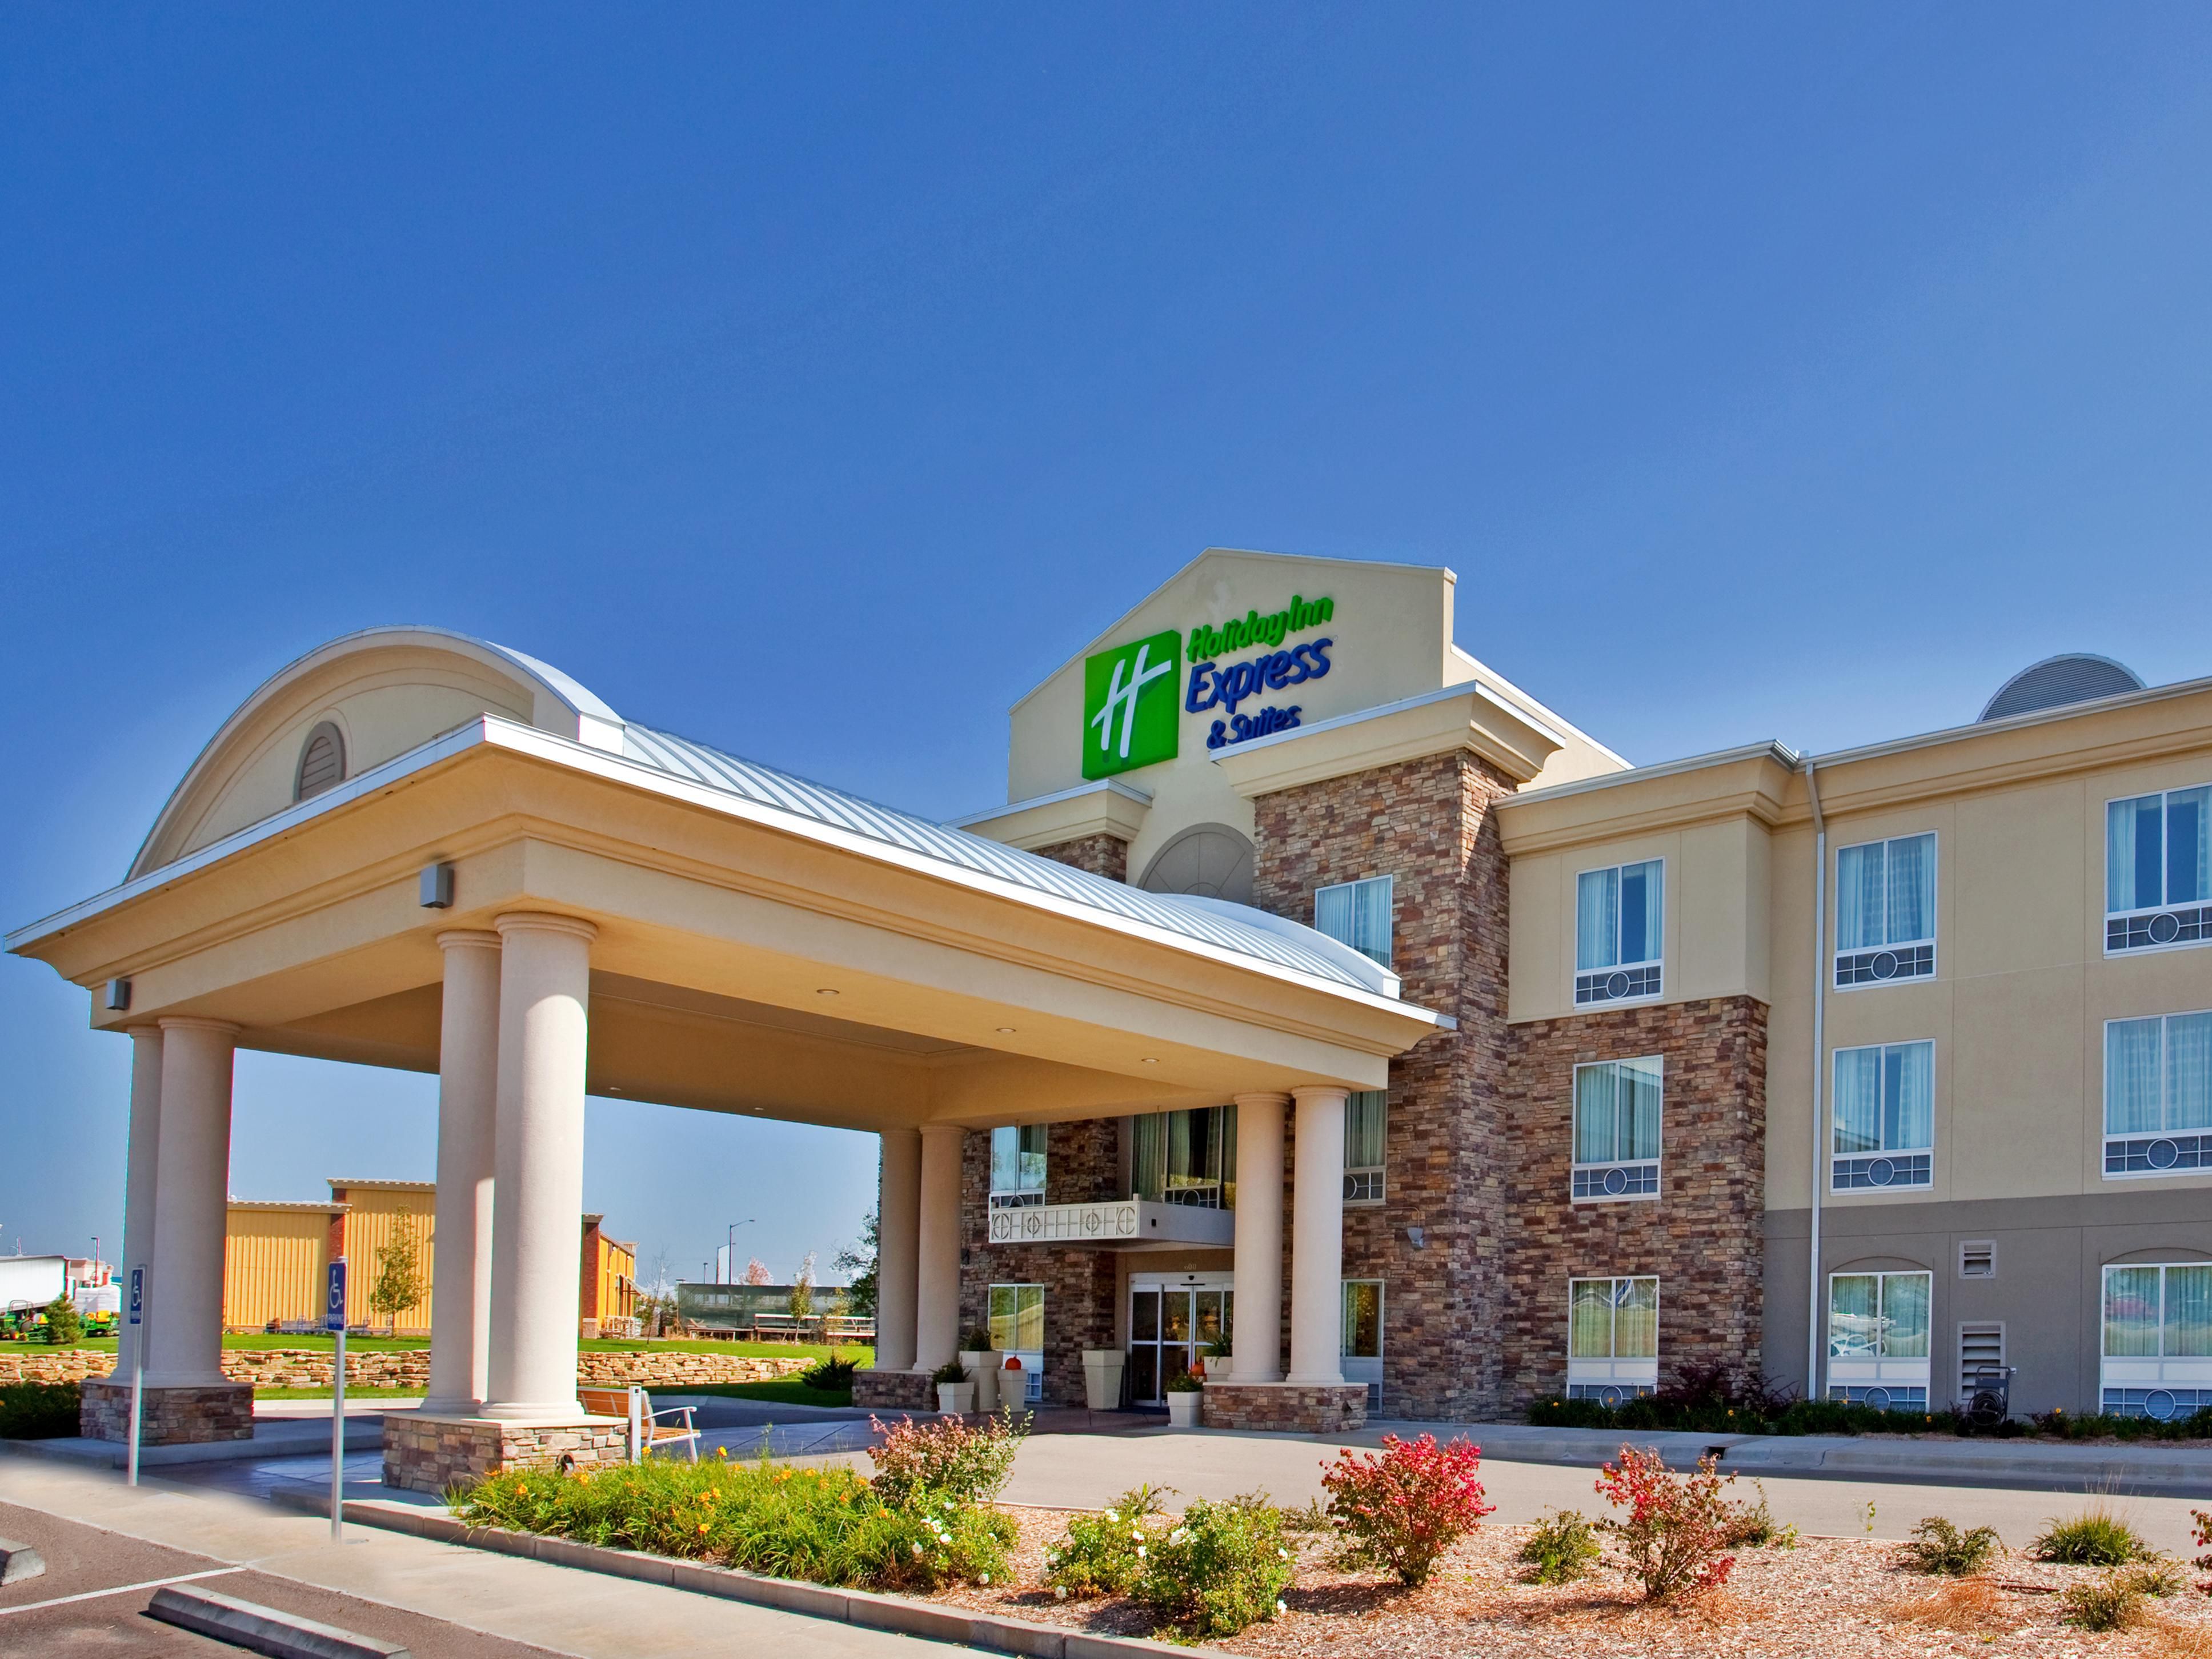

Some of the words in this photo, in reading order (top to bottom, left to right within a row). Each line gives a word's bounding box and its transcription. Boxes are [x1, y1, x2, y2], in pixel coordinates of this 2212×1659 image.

[1185, 638, 1333, 715] Express
[1207, 720, 1227, 750] &
[1228, 705, 1302, 744] Suites
